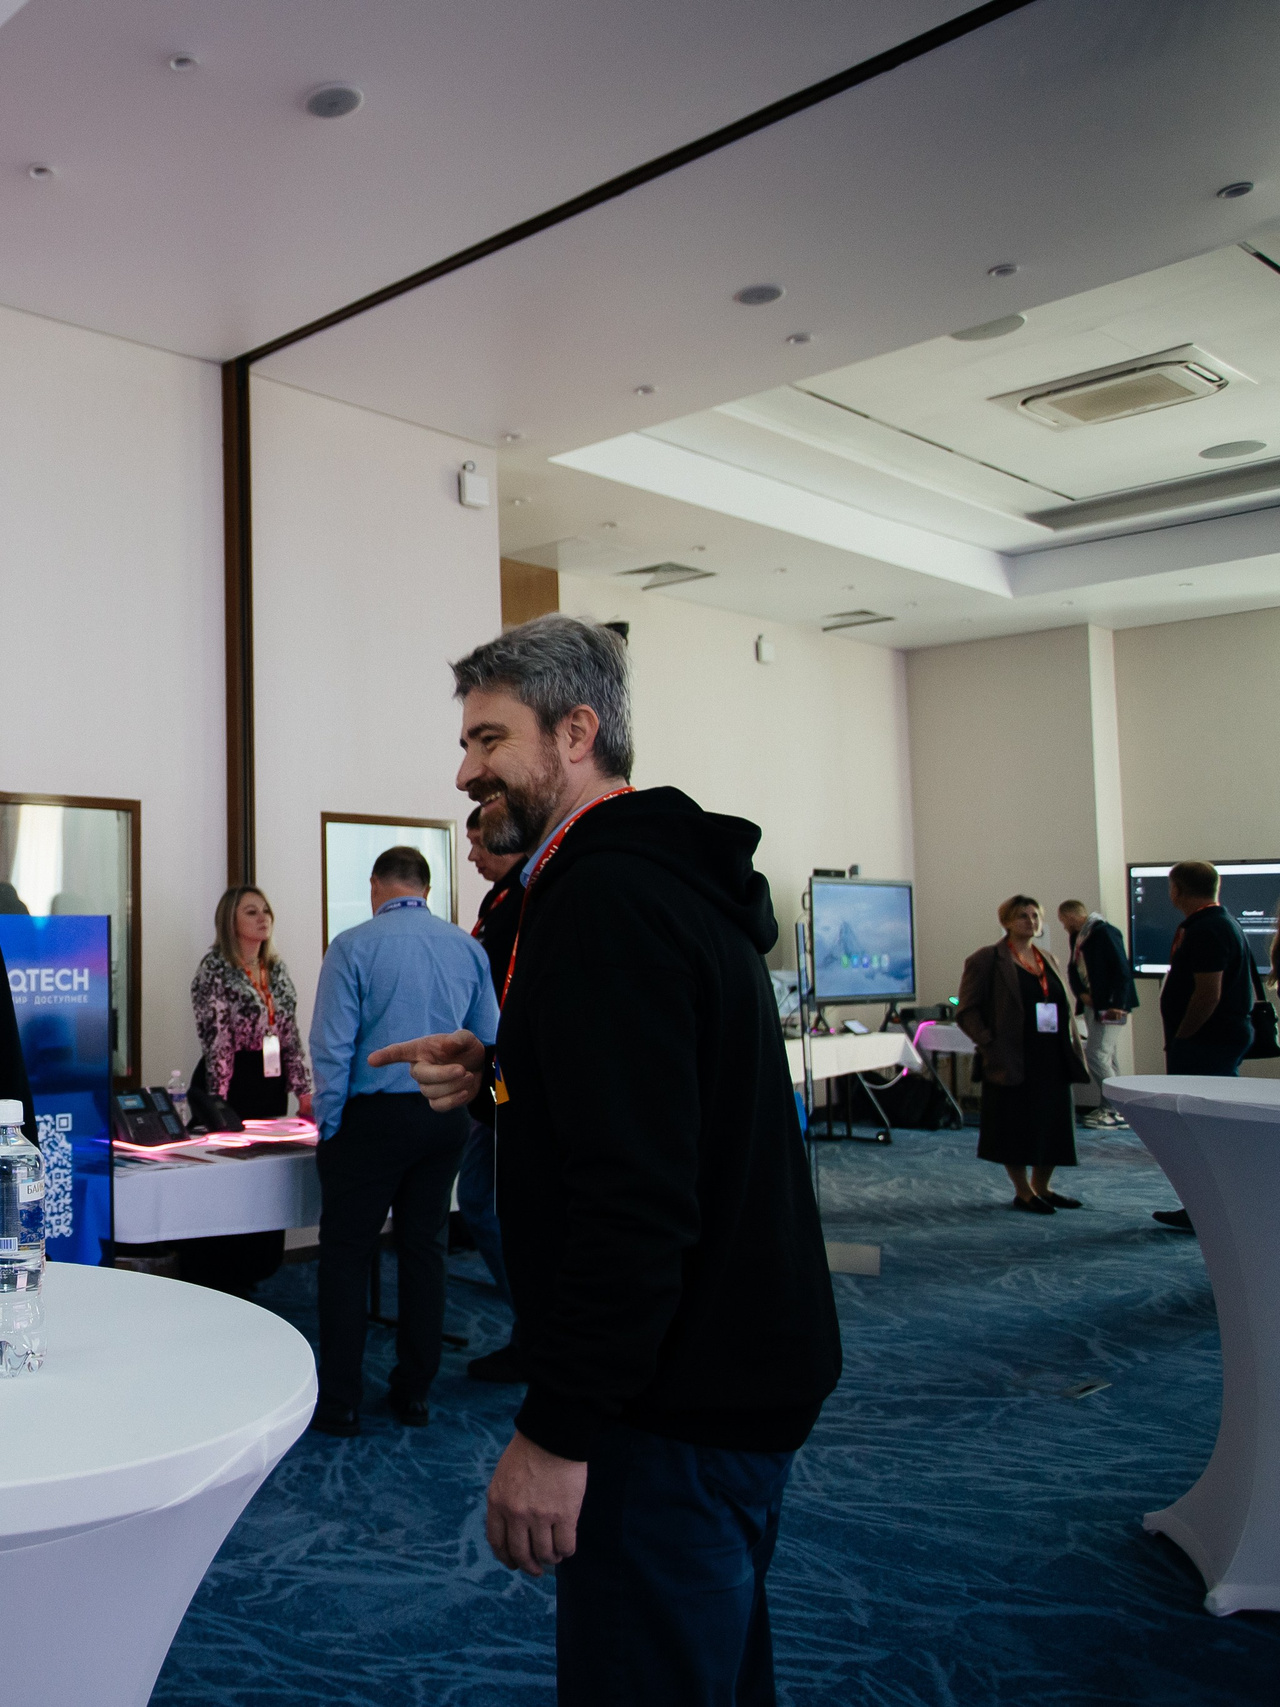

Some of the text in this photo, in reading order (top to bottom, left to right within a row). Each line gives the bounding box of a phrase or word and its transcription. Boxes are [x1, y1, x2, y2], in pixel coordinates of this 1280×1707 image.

[7, 968, 89, 993] QTECH
[13, 995, 88, 1005] ИР ДОСТУПНЕЕ
